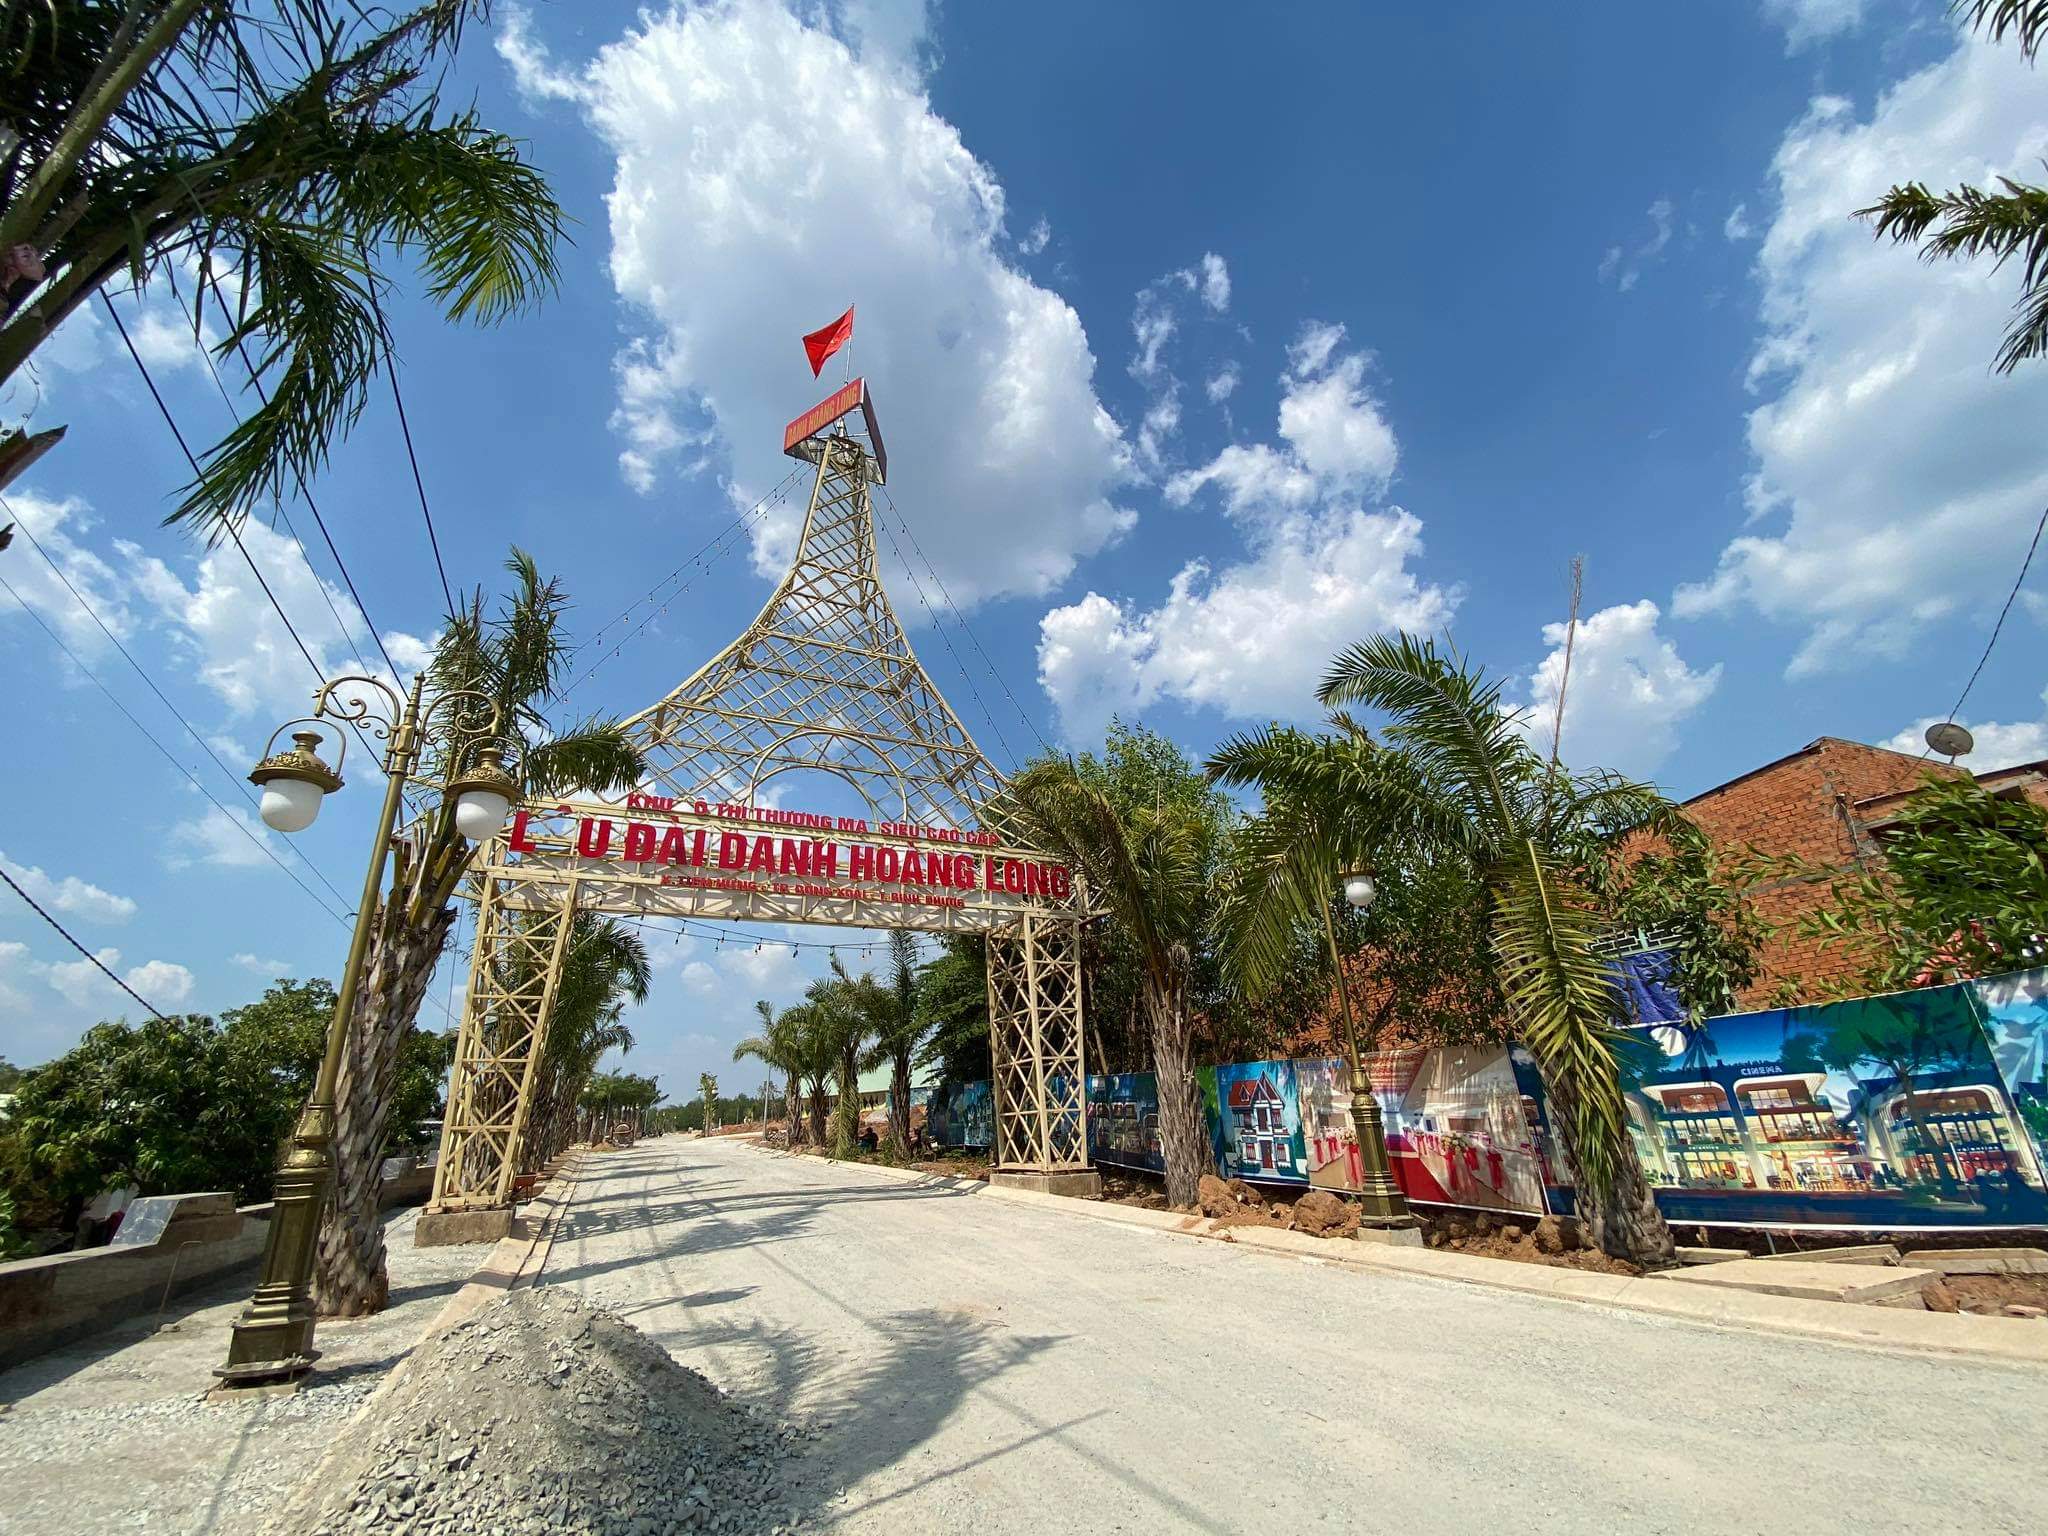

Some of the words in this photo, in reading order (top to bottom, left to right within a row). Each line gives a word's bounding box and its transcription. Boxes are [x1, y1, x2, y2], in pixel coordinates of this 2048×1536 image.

[627, 792, 673, 811] KHU
[719, 831, 837, 877] DANH
[849, 841, 976, 890] HOÀNG
[985, 856, 1070, 898] LONG
[1741, 1065, 1782, 1076] CINEMA
